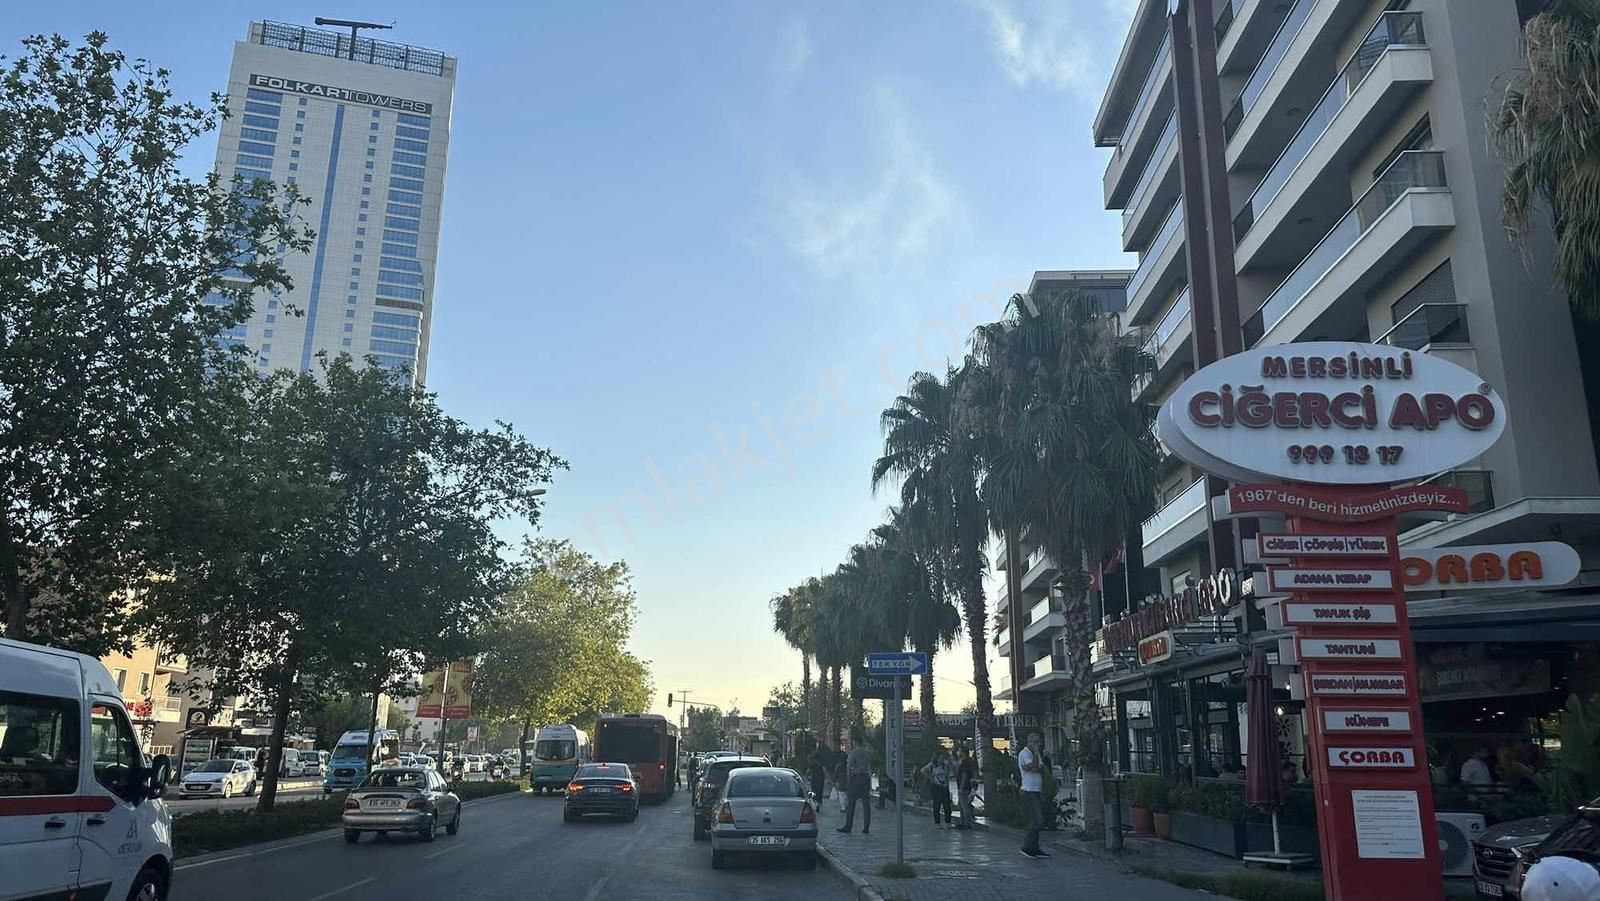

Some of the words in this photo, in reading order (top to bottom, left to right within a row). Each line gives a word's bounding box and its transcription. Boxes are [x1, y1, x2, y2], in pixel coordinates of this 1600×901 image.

[1261, 351, 1413, 379] MERSİNLİ
[1189, 384, 1380, 429] CİĞERCİ
[1388, 392, 1496, 431] APO
[1286, 444, 1335, 465] 999
[1374, 444, 1404, 465] 17
[1237, 489, 1305, 507] 1967'den
[1308, 497, 1337, 514] beri
[1400, 550, 1544, 585] ORBA
[1293, 574, 1335, 585] ADANA
[1336, 573, 1372, 584] KEBAP
[1313, 608, 1351, 619] TAVUK
[1344, 713, 1390, 727] KÜNEFE
[1338, 750, 1405, 766] ÇORBA
